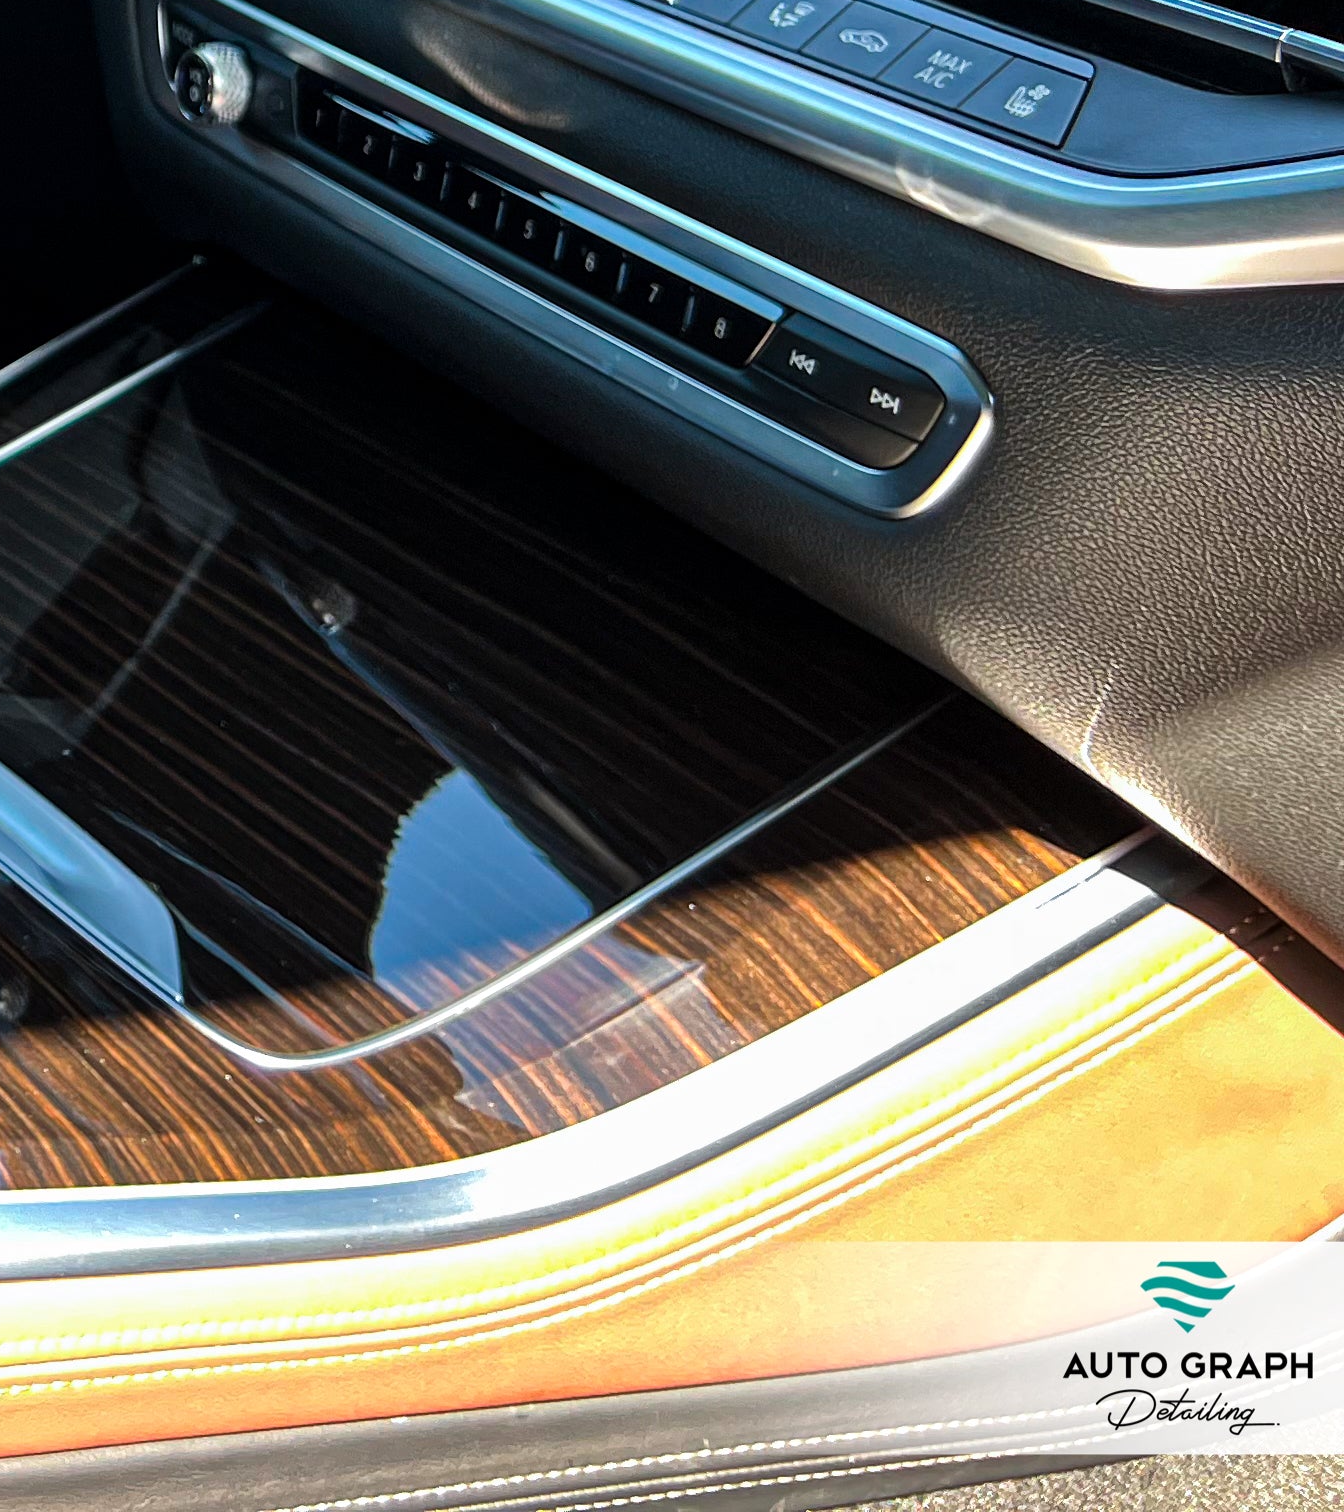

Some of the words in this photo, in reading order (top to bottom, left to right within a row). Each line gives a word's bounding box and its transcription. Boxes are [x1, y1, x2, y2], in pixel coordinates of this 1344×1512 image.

[928, 49, 973, 75] MAX
[913, 66, 954, 89] A/C
[363, 135, 373, 155] 2
[413, 161, 425, 182] 3
[468, 191, 478, 210] 4
[523, 219, 535, 239] 5
[585, 251, 597, 272] 6
[648, 283, 660, 303] 7
[714, 317, 727, 339] 8
